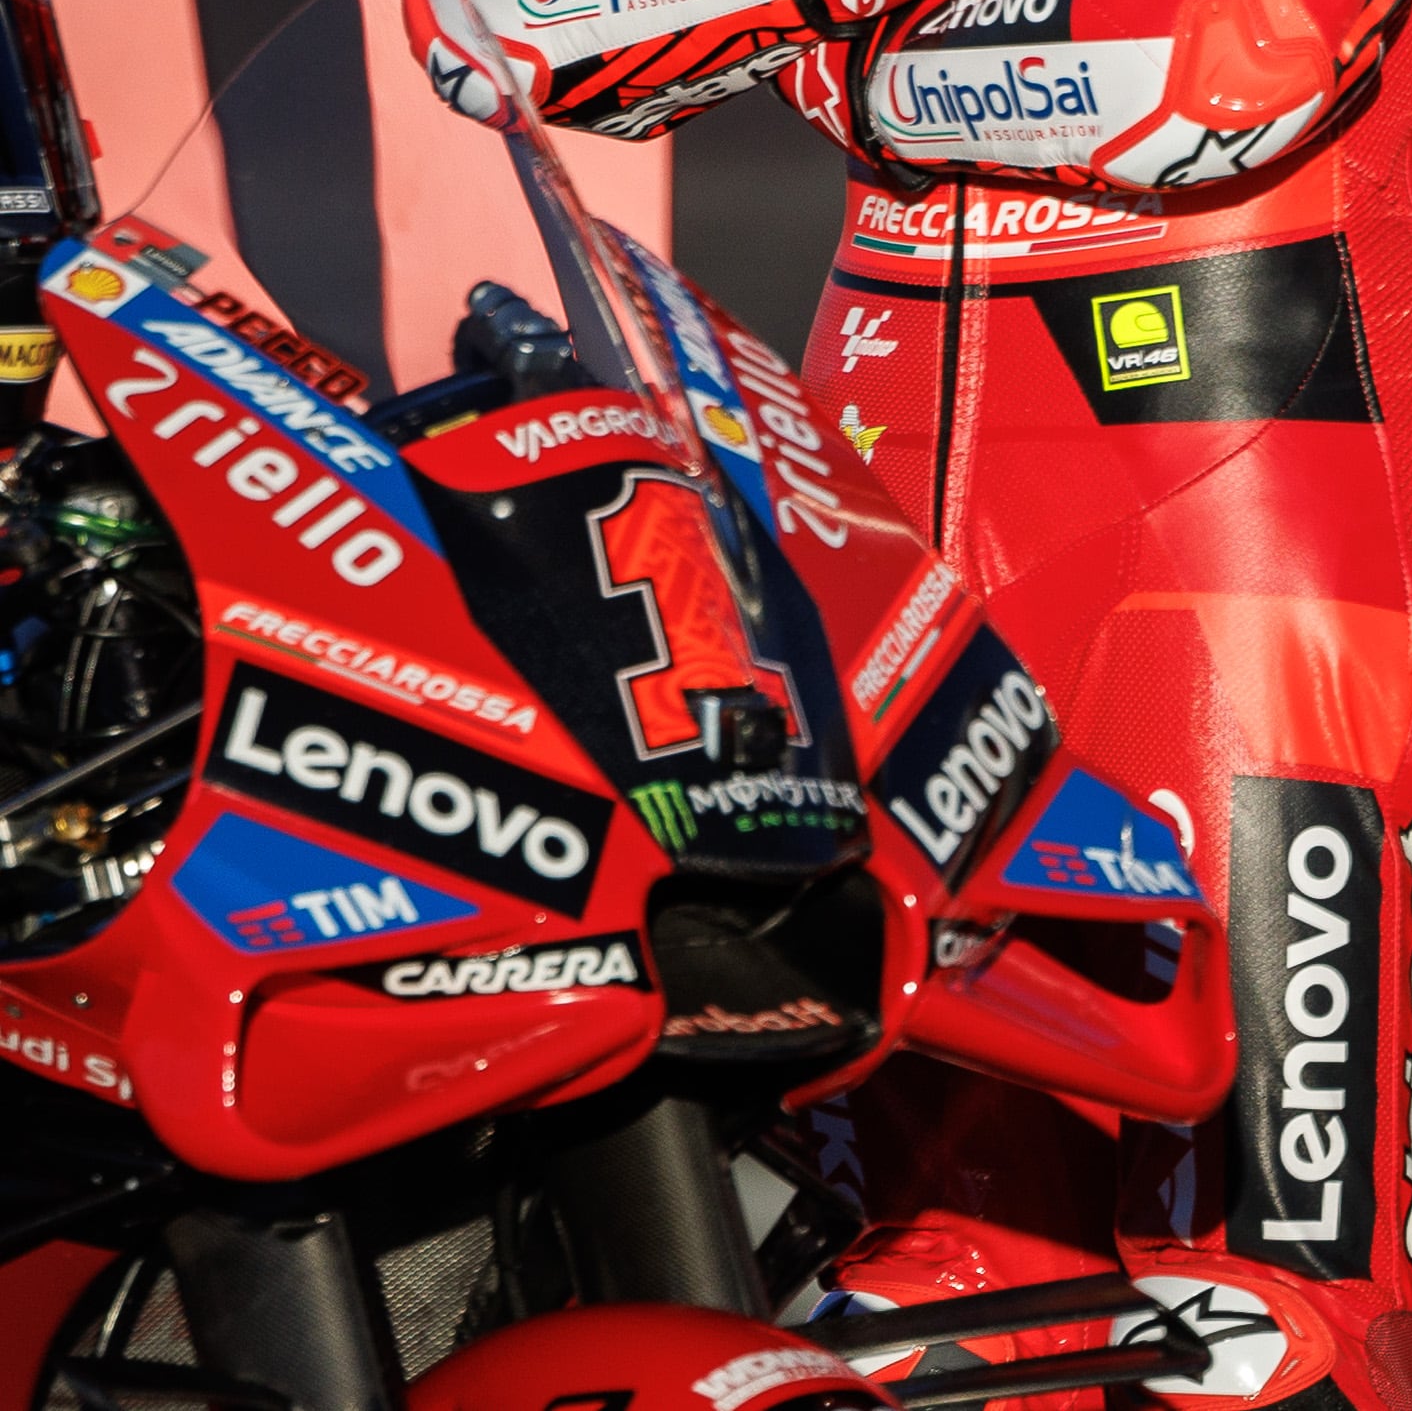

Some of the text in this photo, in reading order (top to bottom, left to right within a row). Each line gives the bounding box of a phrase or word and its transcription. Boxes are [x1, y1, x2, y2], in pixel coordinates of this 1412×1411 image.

[889, 55, 1098, 141] UnipolSai
[142, 319, 394, 475] ADVANCE
[195, 290, 371, 401] PECCO
[728, 331, 842, 509] riello
[154, 399, 404, 587] riello
[221, 602, 538, 733] FRECCIAROSSA
[585, 467, 812, 761] 1
[223, 686, 590, 880] Lenovo
[687, 770, 868, 815] MONSTER
[891, 671, 1046, 865] Lenovo
[294, 877, 420, 938] TIM
[383, 941, 638, 996] CARRERA
[1261, 825, 1352, 1241] Lenovo
